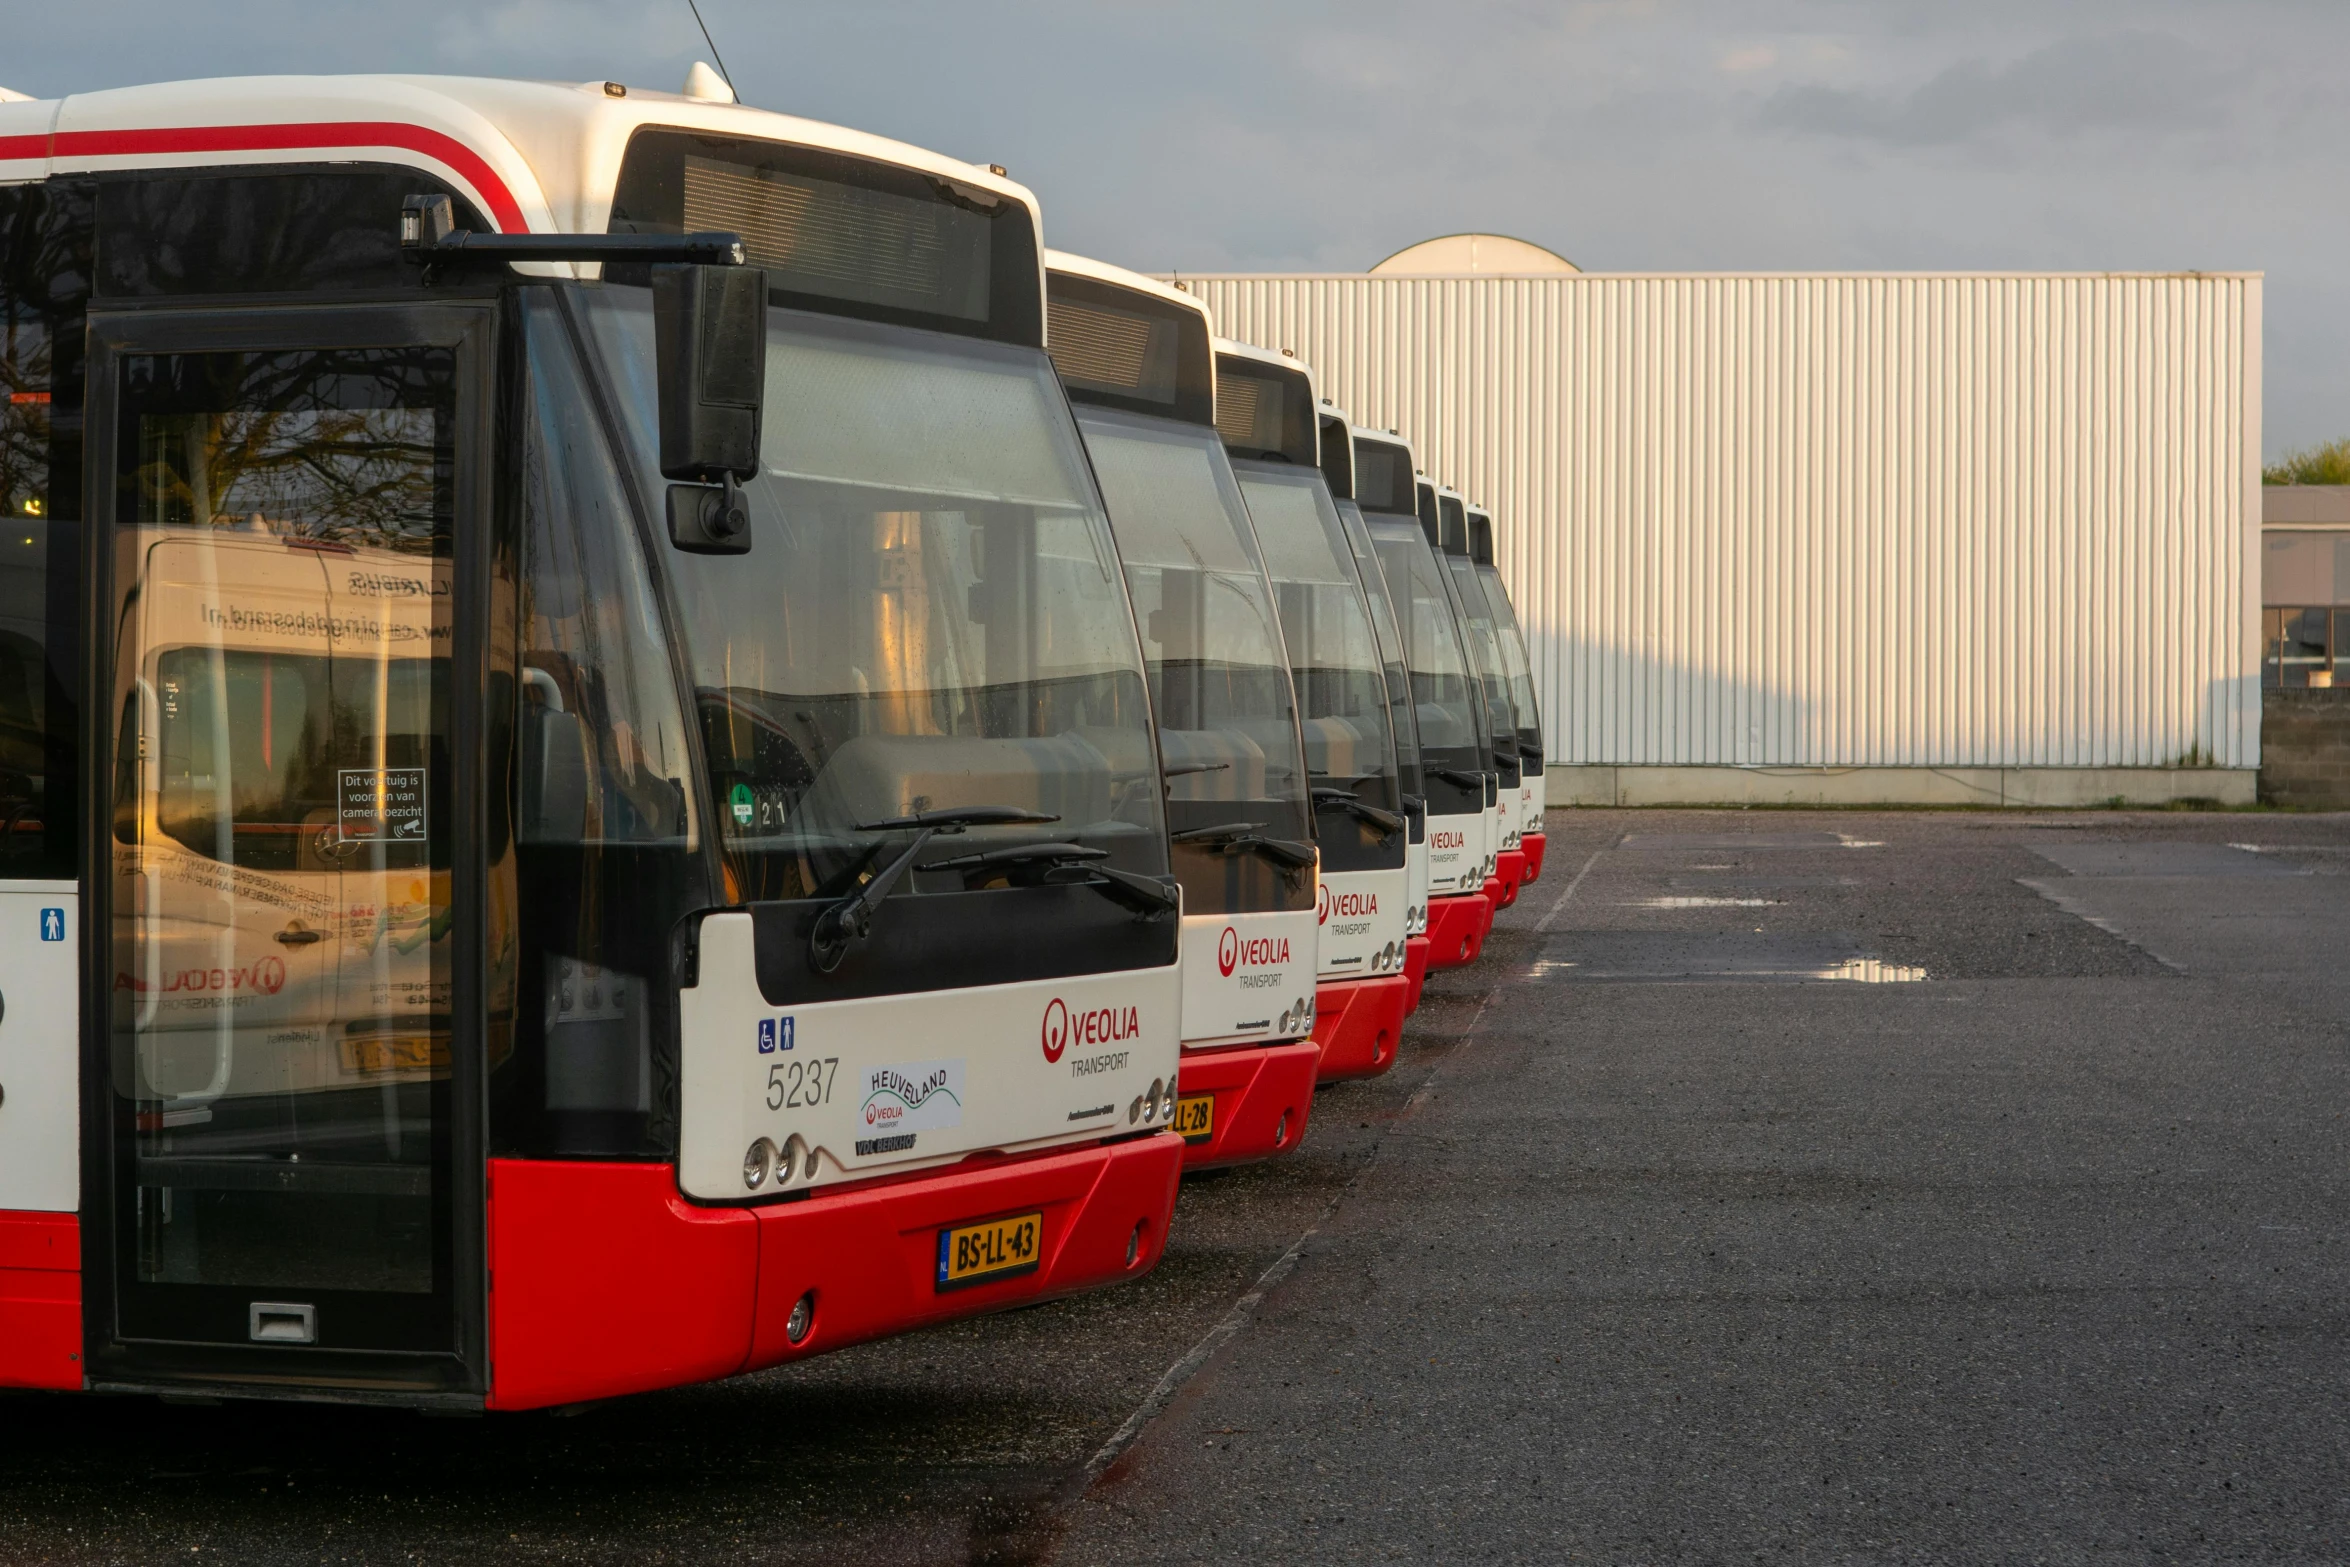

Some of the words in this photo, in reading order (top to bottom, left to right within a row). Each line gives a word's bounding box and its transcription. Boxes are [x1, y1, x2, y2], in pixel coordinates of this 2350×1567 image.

[345, 775, 361, 787] Dit
[410, 774, 419, 785] is
[396, 793, 415, 801] van
[1430, 831, 1465, 849] VEOLIA
[1430, 853, 1460, 863] TRANSPORT
[1332, 893, 1378, 917] VEOLIA
[1331, 923, 1371, 936] TRANSPORT
[1240, 938, 1290, 966] VEOLIA
[1239, 973, 1283, 989] TRANSPORT
[1071, 1006, 1140, 1047] VEOLIA
[1071, 1051, 1130, 1078] TRANSPORT
[766, 1057, 840, 1111] 5237
[871, 1069, 947, 1105] HEUVELLAND
[877, 1106, 903, 1120] VEOLIA
[1172, 1102, 1209, 1132] LL-28
[877, 1121, 899, 1129] TRANSPORT
[856, 1140, 874, 1156] VDL
[876, 1133, 917, 1153] BERKHOF
[957, 1221, 1035, 1272] BS-LL-43
[940, 1261, 948, 1273] NL
